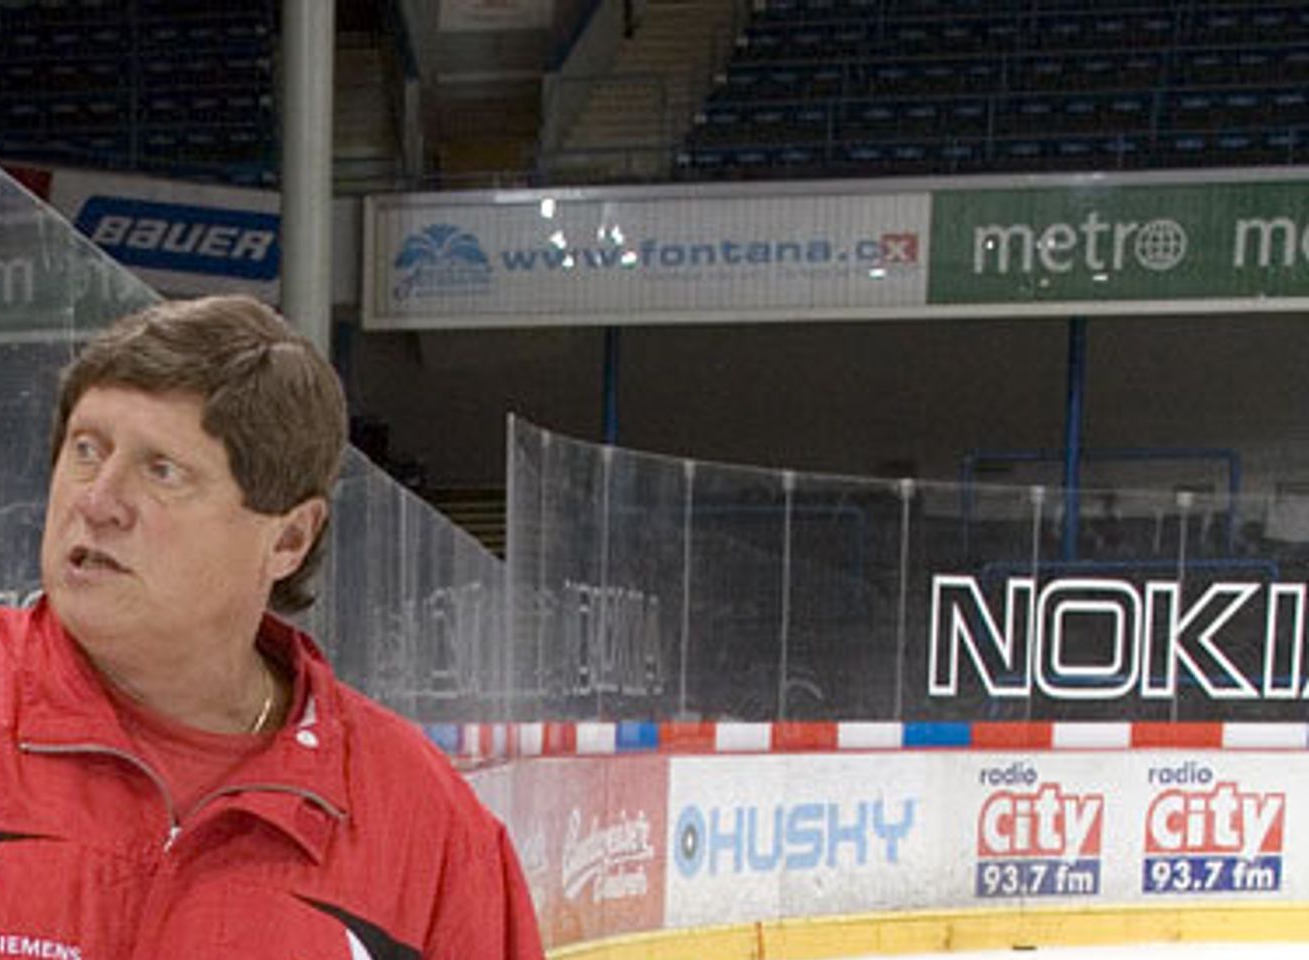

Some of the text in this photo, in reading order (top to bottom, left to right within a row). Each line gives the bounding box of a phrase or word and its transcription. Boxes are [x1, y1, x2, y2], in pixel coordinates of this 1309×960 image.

[928, 575, 1309, 698] NOKI
[979, 762, 1038, 785] radio
[1148, 761, 1213, 783] radio
[708, 797, 918, 877] HUSKY
[983, 864, 1094, 893] 93.7 fm
[1151, 861, 1275, 889] 93.7 fm
